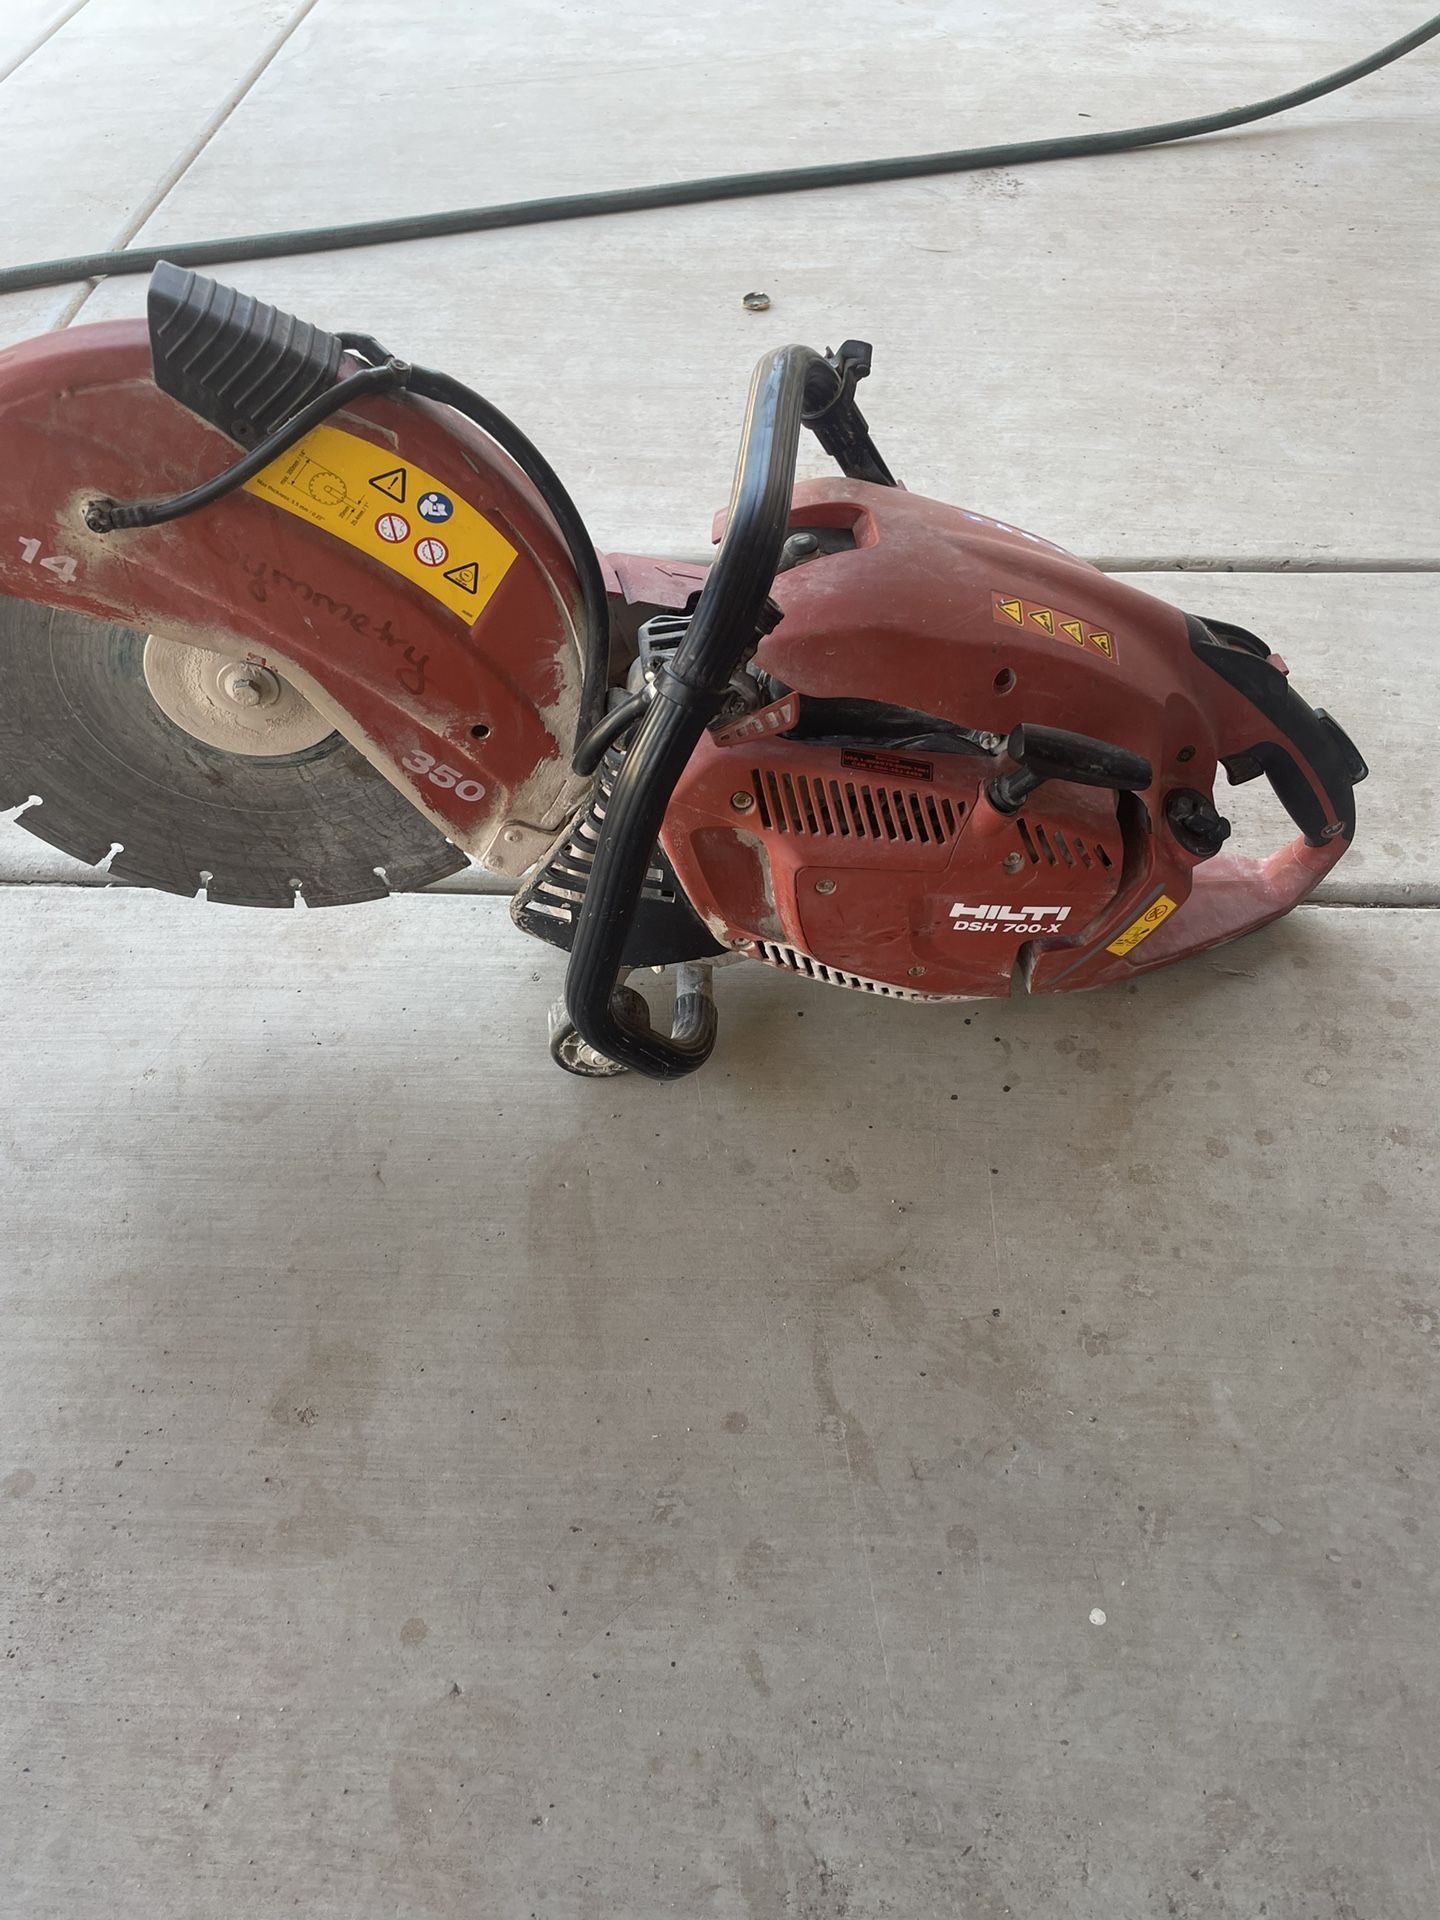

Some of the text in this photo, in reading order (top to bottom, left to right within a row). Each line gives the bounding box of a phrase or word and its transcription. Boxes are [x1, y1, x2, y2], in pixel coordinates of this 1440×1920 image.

[18, 535, 79, 583] 14
[401, 749, 486, 802] 350
[949, 902, 1072, 921] HILTI
[953, 920, 1062, 934] DSH 700-X
